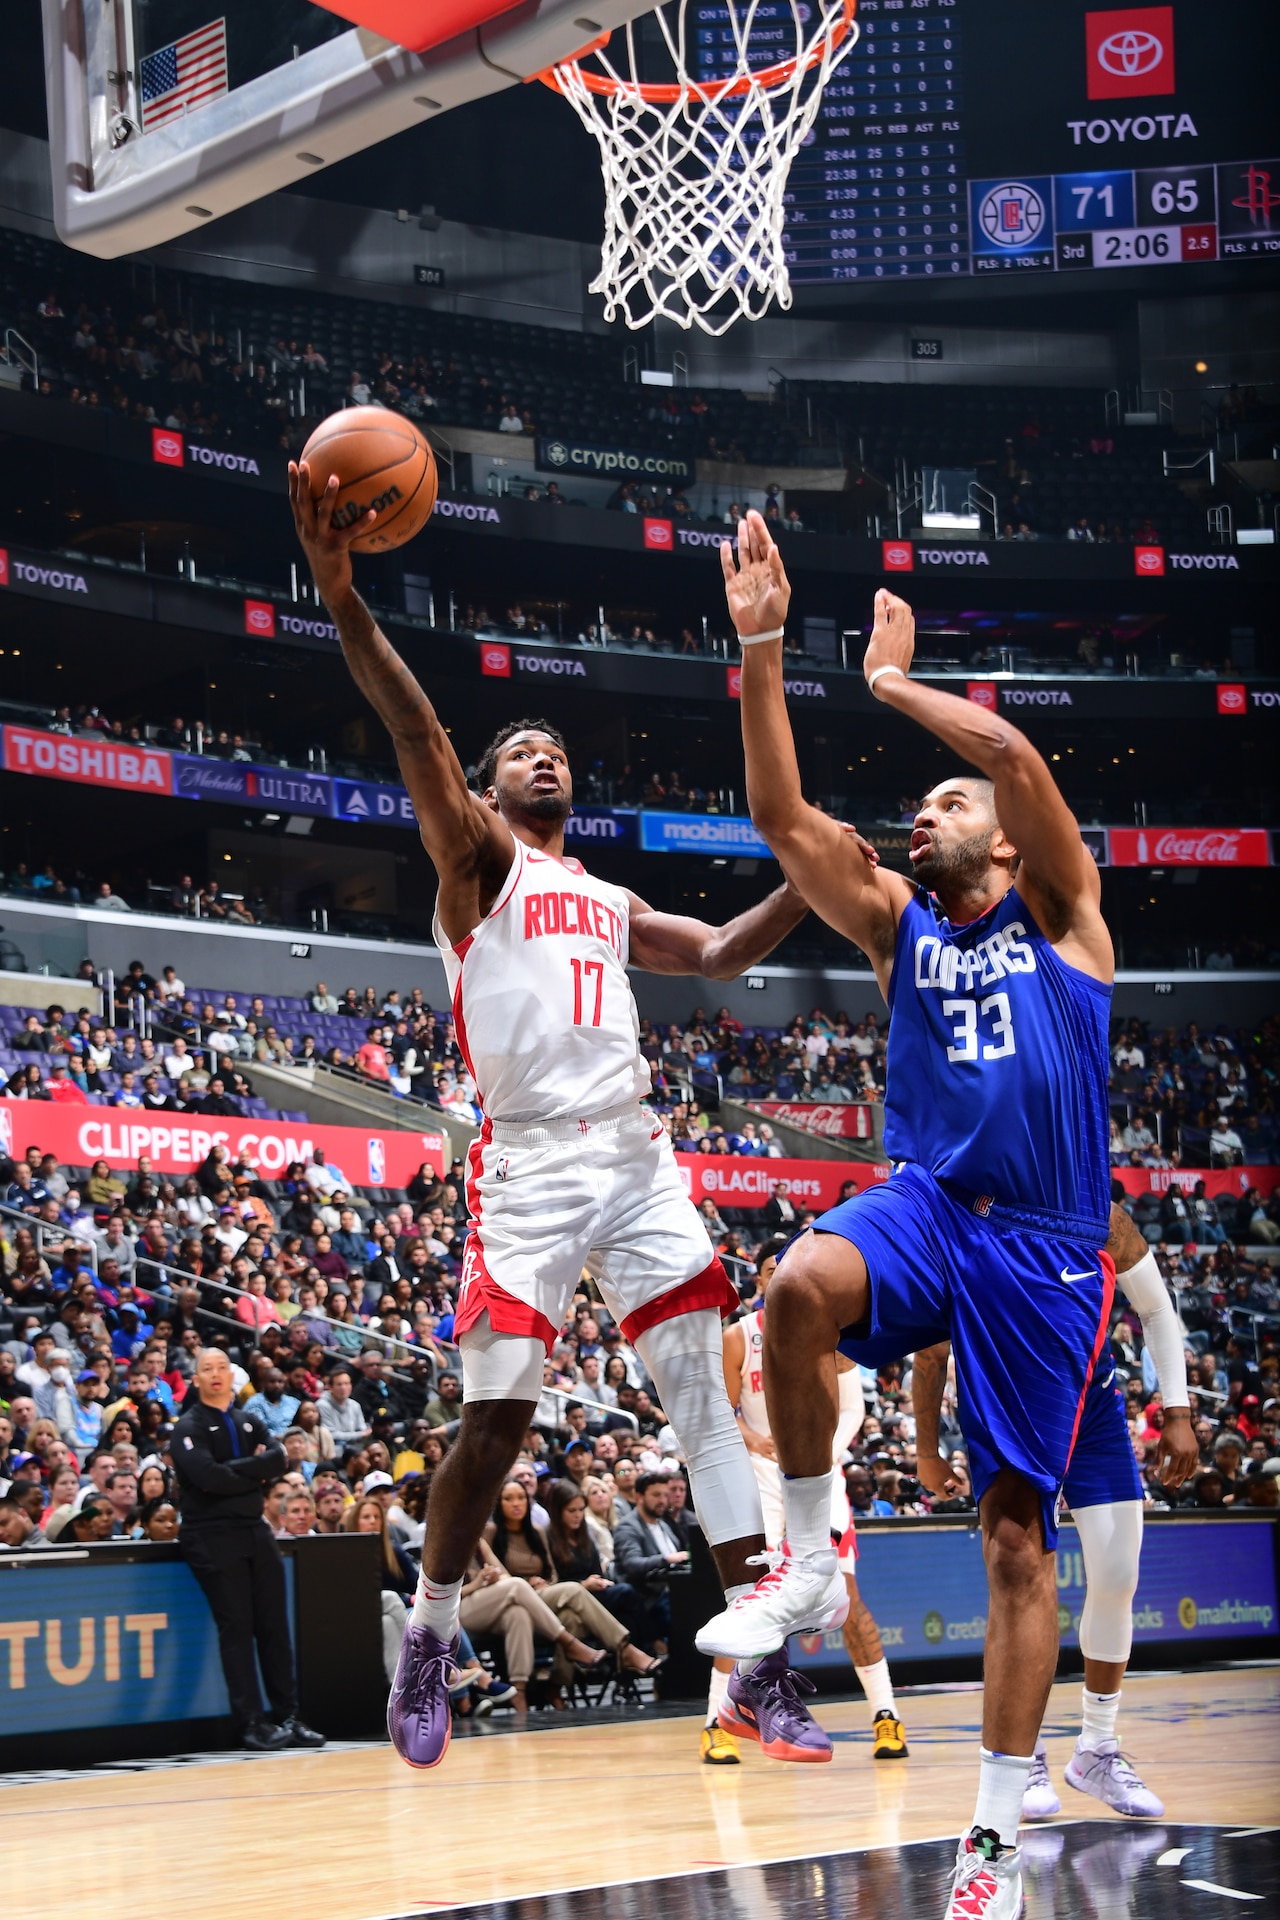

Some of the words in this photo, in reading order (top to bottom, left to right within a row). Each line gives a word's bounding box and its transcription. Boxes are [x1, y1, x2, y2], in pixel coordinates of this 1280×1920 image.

[698, 10, 716, 20] ON
[741, 8, 776, 17] FOOR
[860, 1, 878, 11] PTS
[884, 0, 904, 10] REB
[911, 0, 930, 8] AST
[705, 33, 713, 43] 5
[866, 23, 874, 34] 8
[891, 22, 899, 32] 6
[917, 20, 925, 31] 2
[944, 19, 950, 29] 1
[705, 53, 713, 64] 8
[722, 51, 774, 63] M.orris
[867, 43, 875, 54] 8
[892, 42, 900, 53] 2
[917, 41, 926, 51] 2
[944, 39, 952, 50] 0
[867, 64, 876, 75] 4
[892, 63, 901, 73] 0
[918, 62, 925, 72] 1
[944, 60, 953, 71] 0
[823, 86, 855, 97] 14:14
[868, 84, 876, 94] 7
[894, 83, 900, 93] 1
[918, 81, 927, 92] 0
[946, 79, 952, 90] 1
[823, 106, 855, 117] 10:10
[869, 104, 878, 115] 2
[894, 103, 902, 114] 2
[920, 101, 927, 112] 3
[946, 99, 954, 110] 2
[828, 128, 850, 137] MIN
[864, 126, 883, 136] PTS
[888, 124, 908, 134] REB
[915, 123, 935, 132] AST
[941, 121, 960, 131] FLS
[1067, 114, 1198, 145] TOYOTA
[824, 149, 856, 161] 26:44
[867, 148, 882, 159] 25
[896, 147, 904, 157] 5
[921, 145, 929, 156] 5
[948, 144, 954, 154] 1
[825, 169, 857, 181] 23:38
[869, 168, 883, 178] 12
[896, 166, 904, 177] 9
[921, 165, 930, 176] 0
[948, 164, 956, 174] 4
[826, 188, 858, 200] 21:39
[872, 187, 880, 197] 4
[897, 186, 905, 196] 0
[922, 185, 931, 195] 5
[948, 183, 957, 194] 0
[1071, 185, 1114, 219] 71
[1151, 179, 1199, 215] 65
[829, 208, 855, 219] 4:33
[874, 207, 880, 217] 1
[898, 206, 906, 216] 2
[922, 204, 931, 215] 0
[950, 203, 956, 213] 1
[830, 229, 856, 239] 0:00
[873, 227, 882, 238] 0
[898, 226, 907, 236] 0
[923, 224, 932, 235] 0
[950, 223, 958, 234] 0
[831, 248, 857, 259] 0:00
[874, 247, 882, 257] 0
[899, 245, 908, 256] 0
[924, 244, 933, 255] 0
[951, 242, 959, 253] 0
[1063, 244, 1085, 260] 3rd
[1105, 233, 1169, 261] 2:06
[1188, 237, 1210, 251] 2.5
[1224, 243, 1246, 253] FLS:
[1251, 241, 1259, 251] 4
[832, 267, 858, 278] 7:10
[875, 266, 883, 276] 0
[900, 264, 908, 275] 2
[925, 263, 933, 274] 0
[952, 262, 960, 272] 0
[978, 257, 999, 269] FLS:
[1004, 258, 1011, 268] 2
[1016, 257, 1042, 267] TOL:
[1043, 256, 1050, 266] 4
[419, 269, 440, 284] 304
[917, 342, 937, 355] 305
[188, 445, 260, 475] TOYOTA
[570, 448, 688, 476] crypto.com
[918, 550, 990, 566] TOYOTA
[1169, 554, 1240, 570] TOYOTA
[13, 562, 88, 593] TOYOTA
[515, 655, 586, 677] TOYOTA
[783, 681, 826, 697] YOTA
[1001, 691, 1072, 706] TOYOTA
[11, 735, 165, 787] TOSHIBA
[179, 766, 244, 793] Michelob
[259, 777, 327, 806] ULTRA
[1155, 832, 1241, 861] Coca-Cola
[915, 921, 1037, 992] CLIPPERS
[570, 957, 604, 1027] 17
[942, 992, 1016, 1063] 33
[78, 1120, 315, 1170] CLIPPERS.COM
[423, 1136, 442, 1151] 102
[1198, 1599, 1273, 1629] mailchimp
[0, 1612, 168, 1690] TUIT
